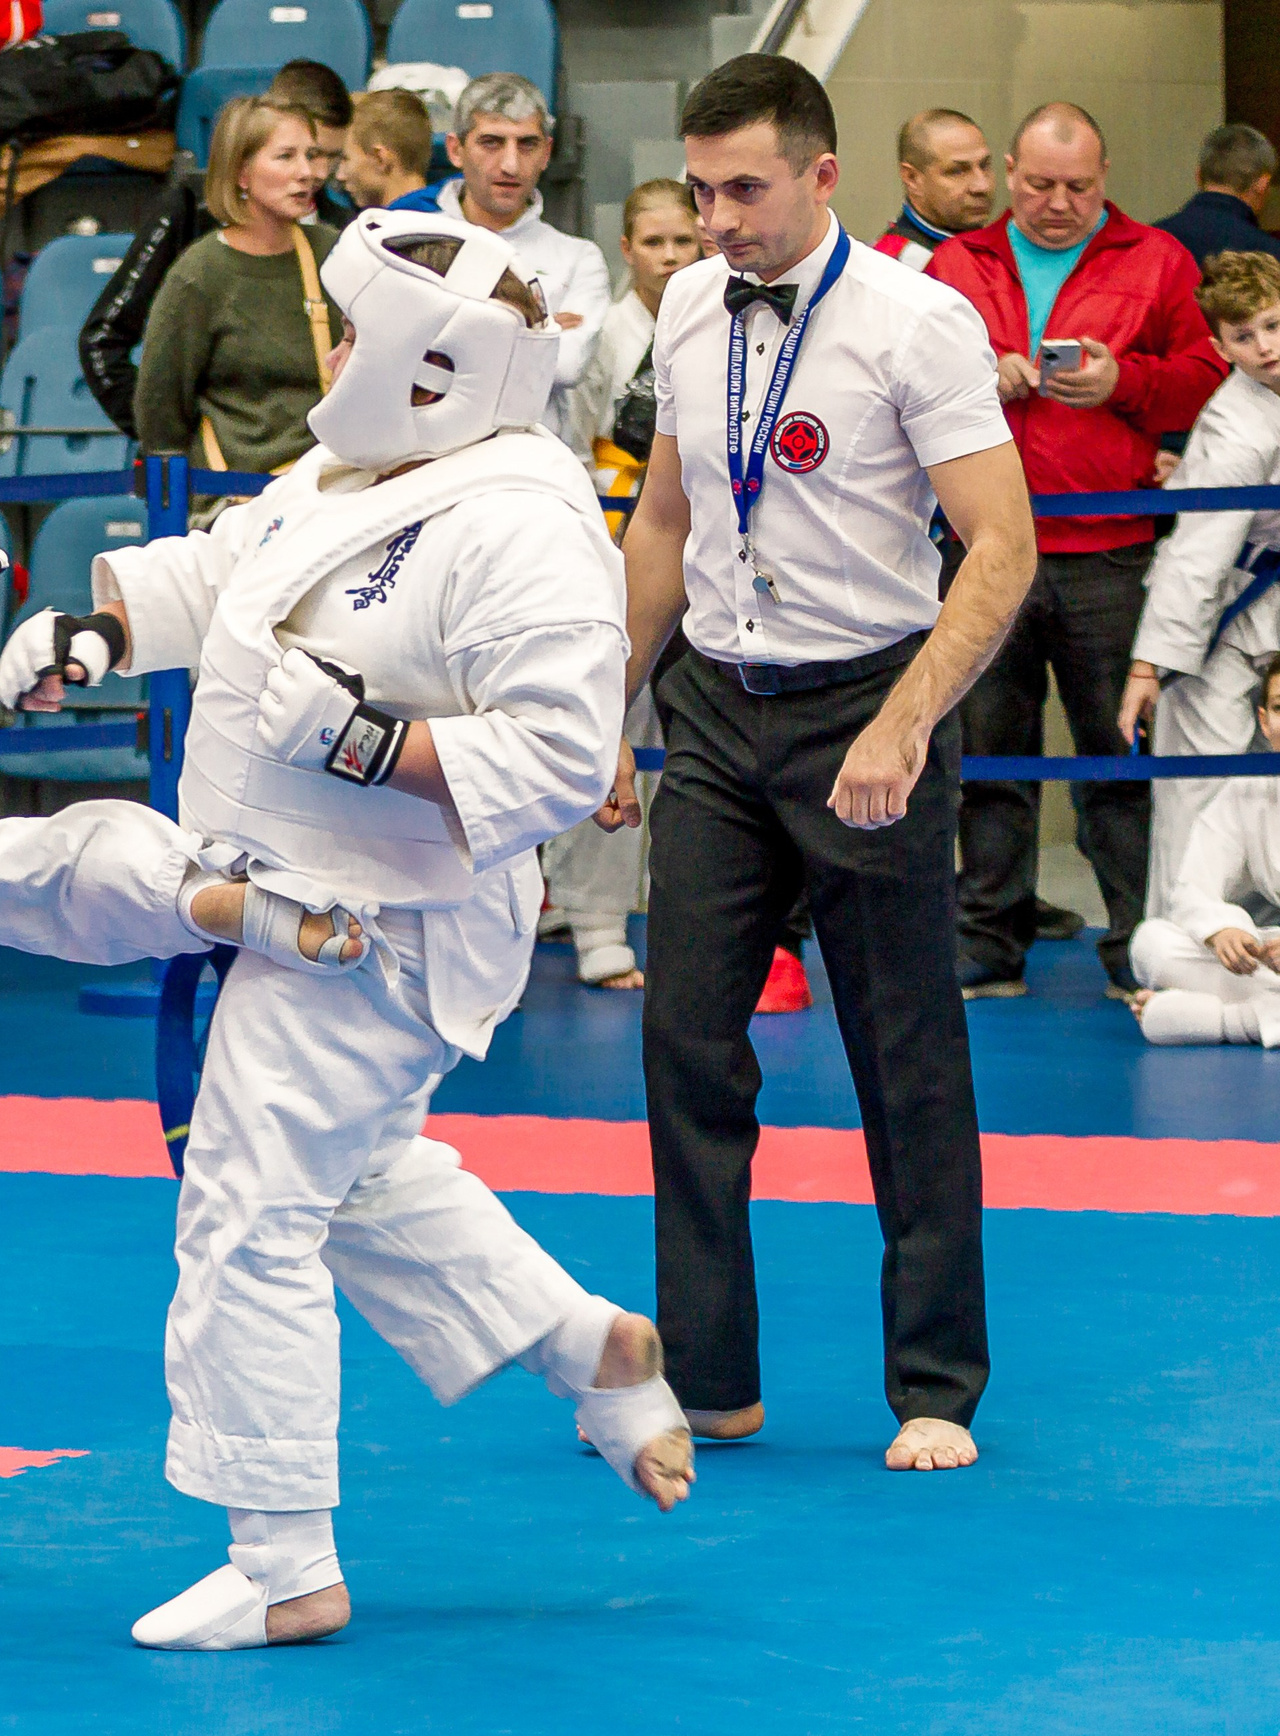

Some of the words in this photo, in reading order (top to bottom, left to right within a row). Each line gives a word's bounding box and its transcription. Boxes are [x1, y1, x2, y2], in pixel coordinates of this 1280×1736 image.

[733, 309, 745, 337] РОСС
[730, 338, 744, 393] КИОКУШИН
[766, 359, 791, 415] КИОКУШИН
[729, 396, 740, 454] ФЕДЕРАЦИЯ
[753, 415, 774, 454] РОССИИ
